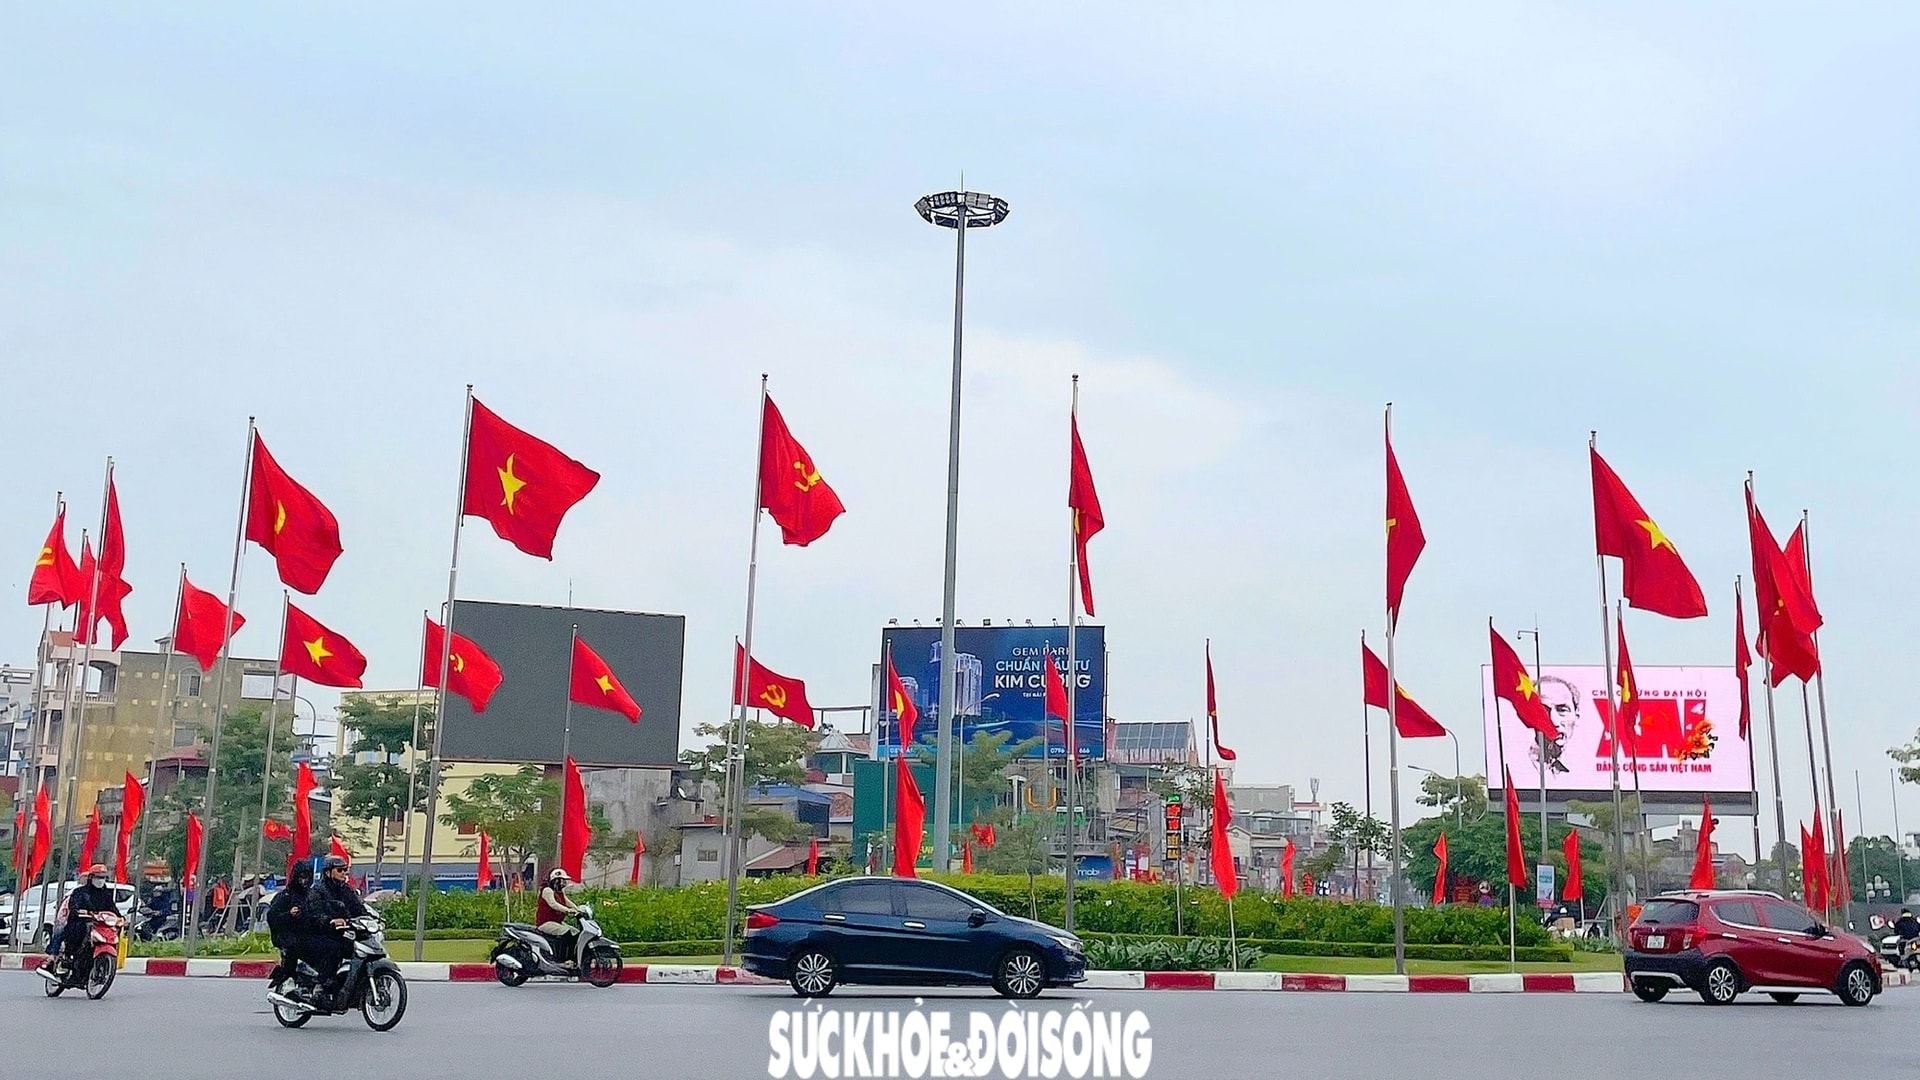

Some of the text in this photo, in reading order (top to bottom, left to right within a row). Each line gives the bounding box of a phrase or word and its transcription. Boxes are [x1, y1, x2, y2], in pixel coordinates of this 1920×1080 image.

[1012, 647, 1038, 656] GEM
[995, 674, 1023, 688] KIM
[1691, 763, 1712, 772] NAM
